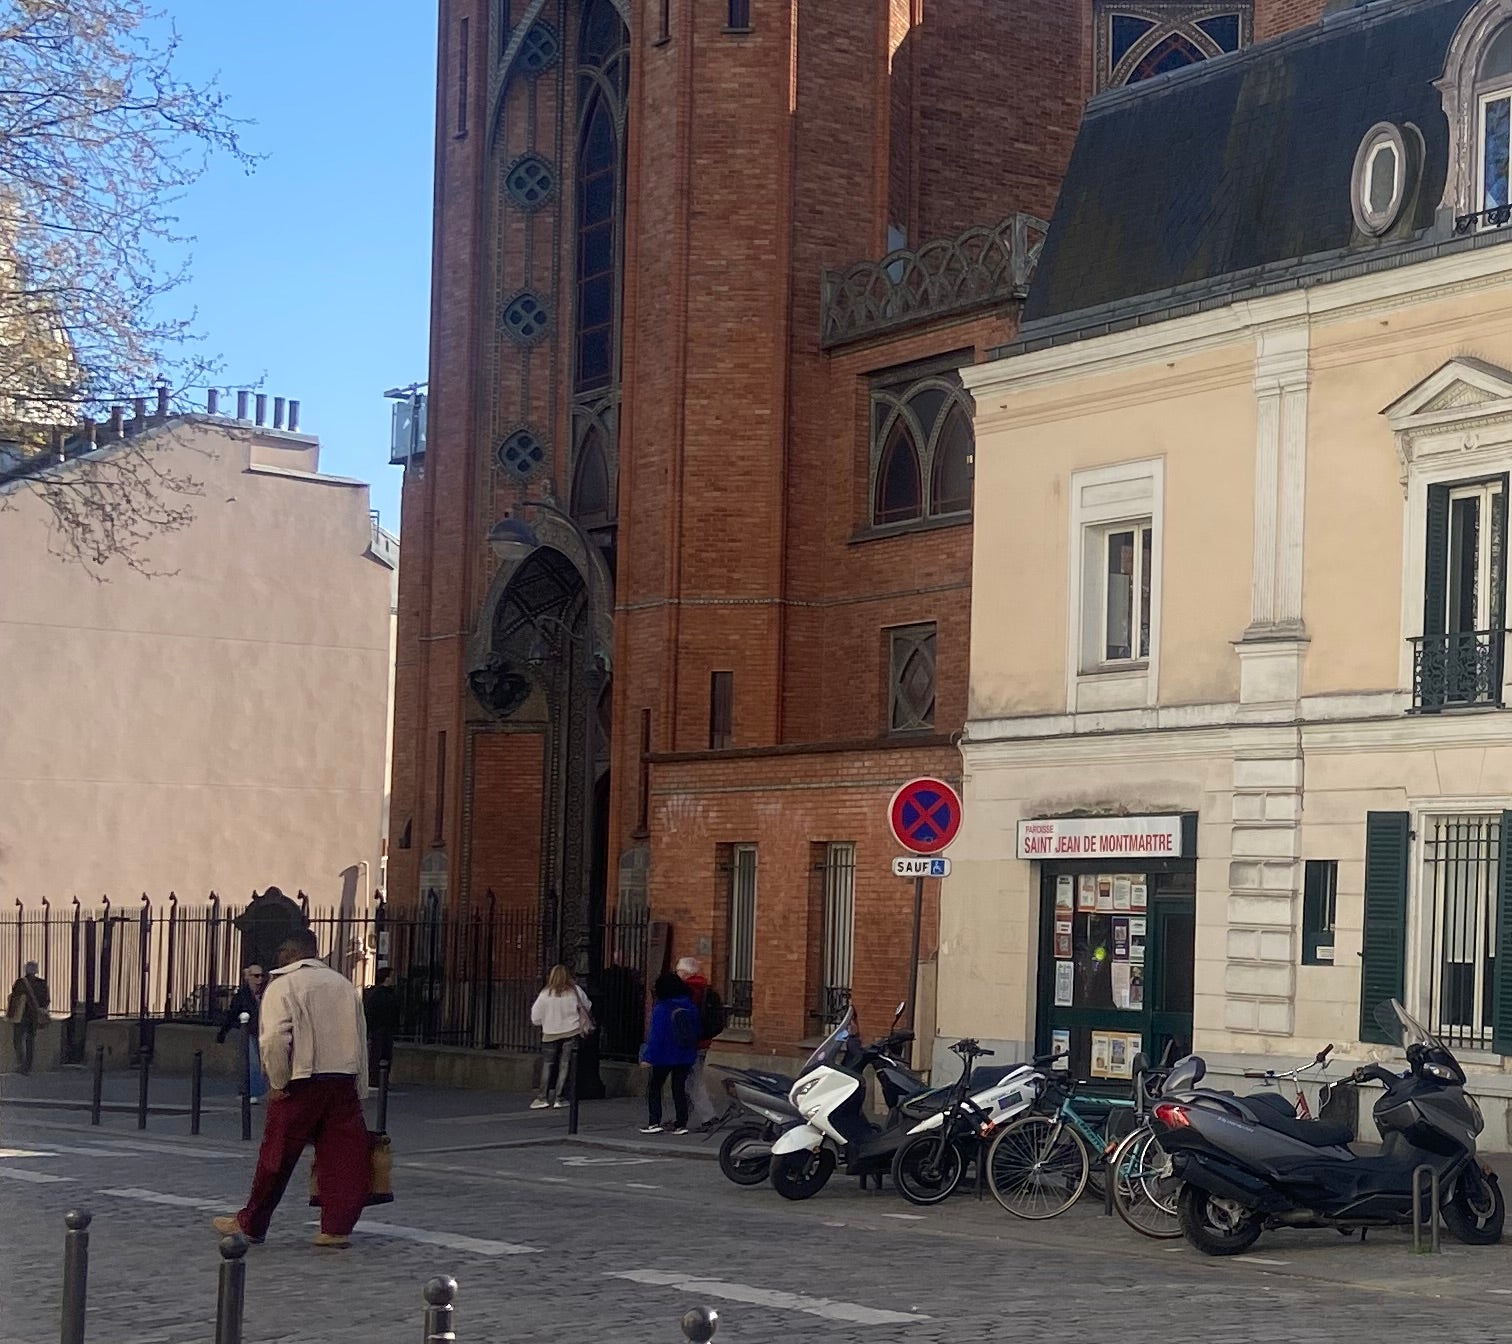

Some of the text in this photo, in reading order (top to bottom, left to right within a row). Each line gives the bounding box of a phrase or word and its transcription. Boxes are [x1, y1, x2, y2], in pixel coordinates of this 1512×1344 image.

[1024, 833, 1173, 854] SAINT JEAN DE MONTMARTRE
[897, 861, 929, 873] SAUF
